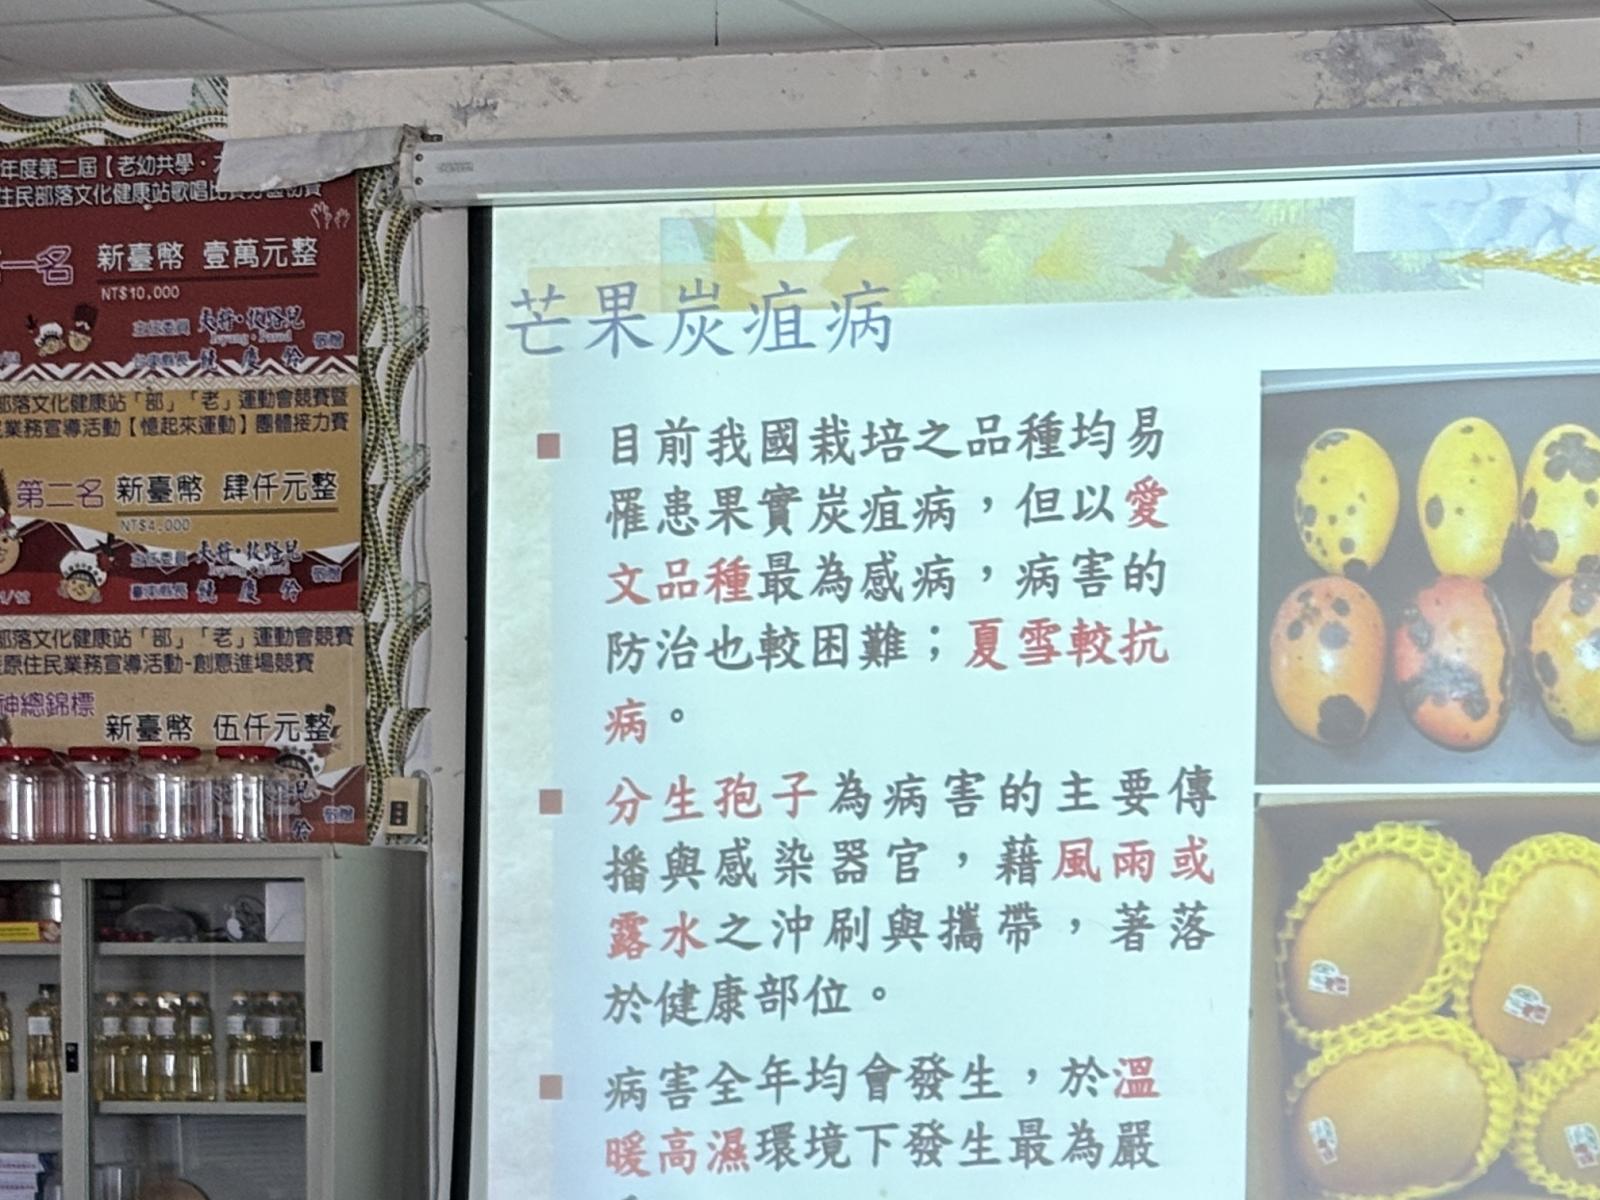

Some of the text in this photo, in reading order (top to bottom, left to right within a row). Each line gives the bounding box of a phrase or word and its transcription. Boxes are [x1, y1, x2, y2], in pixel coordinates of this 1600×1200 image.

[97, 236, 319, 273] 新臺幣 壹萬元整
[505, 278, 894, 358] 芒果炭疽病
[608, 406, 1166, 468] 目前我國栽培之品種均易
[16, 478, 105, 509] 第二名
[116, 473, 204, 504] 新臺幣
[605, 475, 1169, 539] 罹患果實炭疽病，但以愛
[605, 547, 1167, 605] 文品種最為感病，病害的
[605, 617, 1170, 675] 防治也較困難；夏雪較抗
[105, 712, 333, 743] 新臺幣 伍仟元整
[604, 697, 685, 746] 病。
[606, 764, 1218, 827] 分生孢子為病害的主要傳
[603, 833, 1216, 893] 播與感染器官，藉風雨或
[606, 899, 1216, 960] 露水之沖刷與攜帶，著落
[602, 973, 887, 1028] 於健康部位。
[604, 1051, 1161, 1114] 病害全年均會發生，於溫
[604, 1119, 1160, 1179] 暖高濕環境下發生最為嚴
